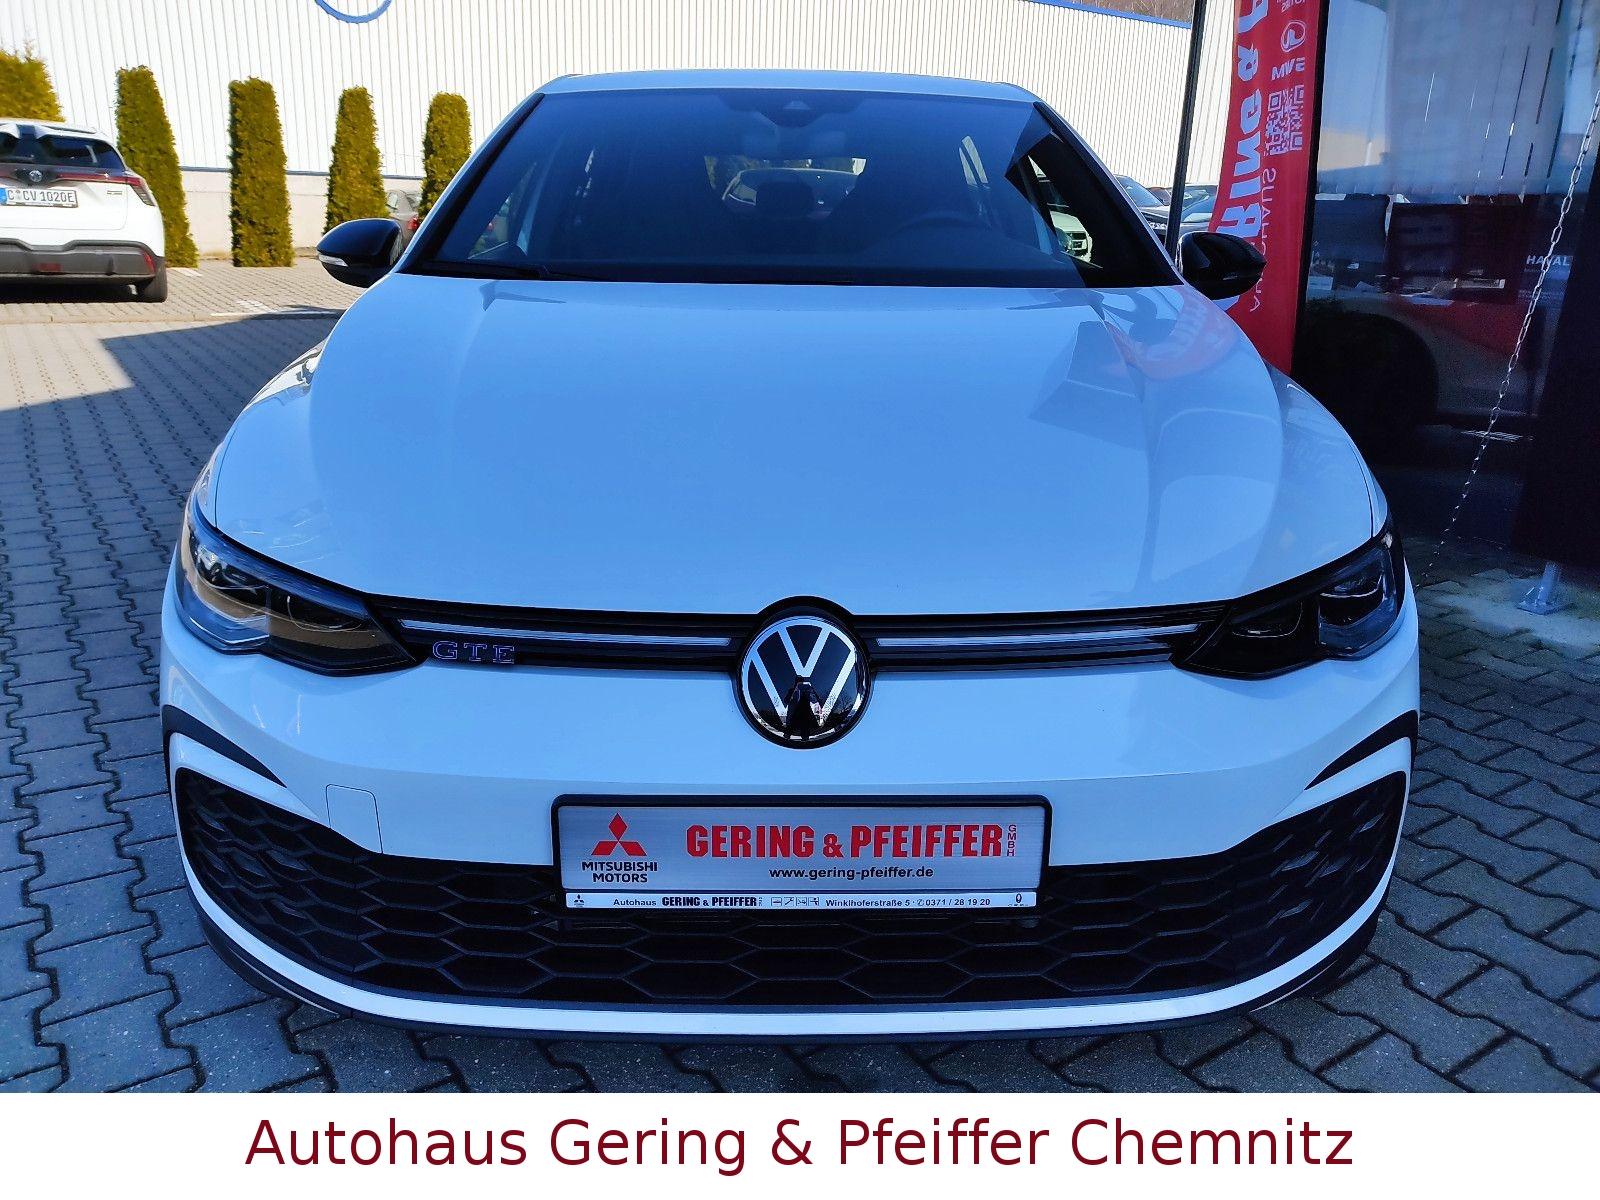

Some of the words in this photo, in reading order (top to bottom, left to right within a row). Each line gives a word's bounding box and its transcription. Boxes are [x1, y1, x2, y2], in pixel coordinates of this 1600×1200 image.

[432, 640, 514, 664] GTE
[686, 824, 815, 858] GERING
[822, 833, 844, 858] &
[850, 824, 1003, 858] PFEIFFER
[1006, 824, 1017, 857] GMBH
[581, 861, 658, 872] MITSUBISHI
[592, 872, 648, 883] MOTORS
[768, 865, 934, 880] www.gering-pfeiffer.de
[613, 897, 657, 906] Autohaus
[661, 896, 701, 907] GERING
[702, 899, 710, 907] &
[711, 896, 757, 907] PFEIFFER
[825, 898, 903, 907] Winklhoferstraße
[954, 898, 965, 906] 28
[967, 898, 978, 906] 19
[979, 898, 991, 906] 20
